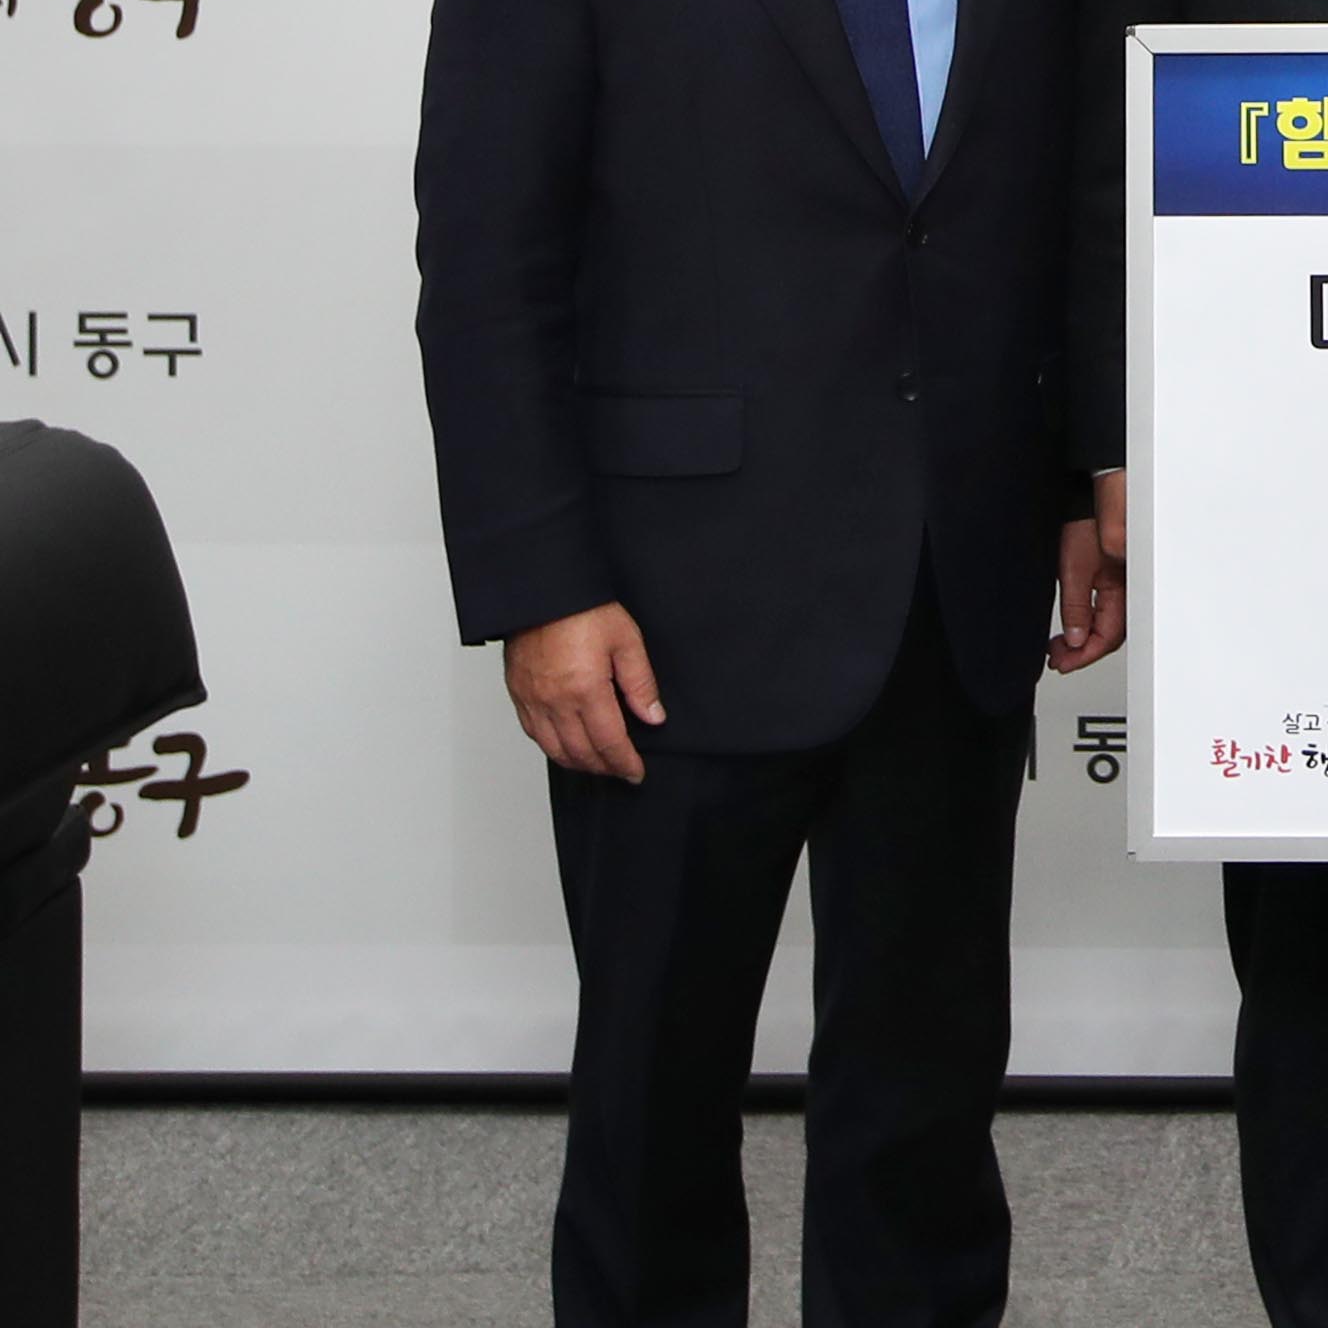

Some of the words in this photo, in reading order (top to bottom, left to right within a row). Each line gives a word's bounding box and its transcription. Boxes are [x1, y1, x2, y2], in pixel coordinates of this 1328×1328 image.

[73, 311, 203, 380] 동구
[1282, 713, 1321, 734] 살고
[1209, 738, 1292, 778] 활기찬
